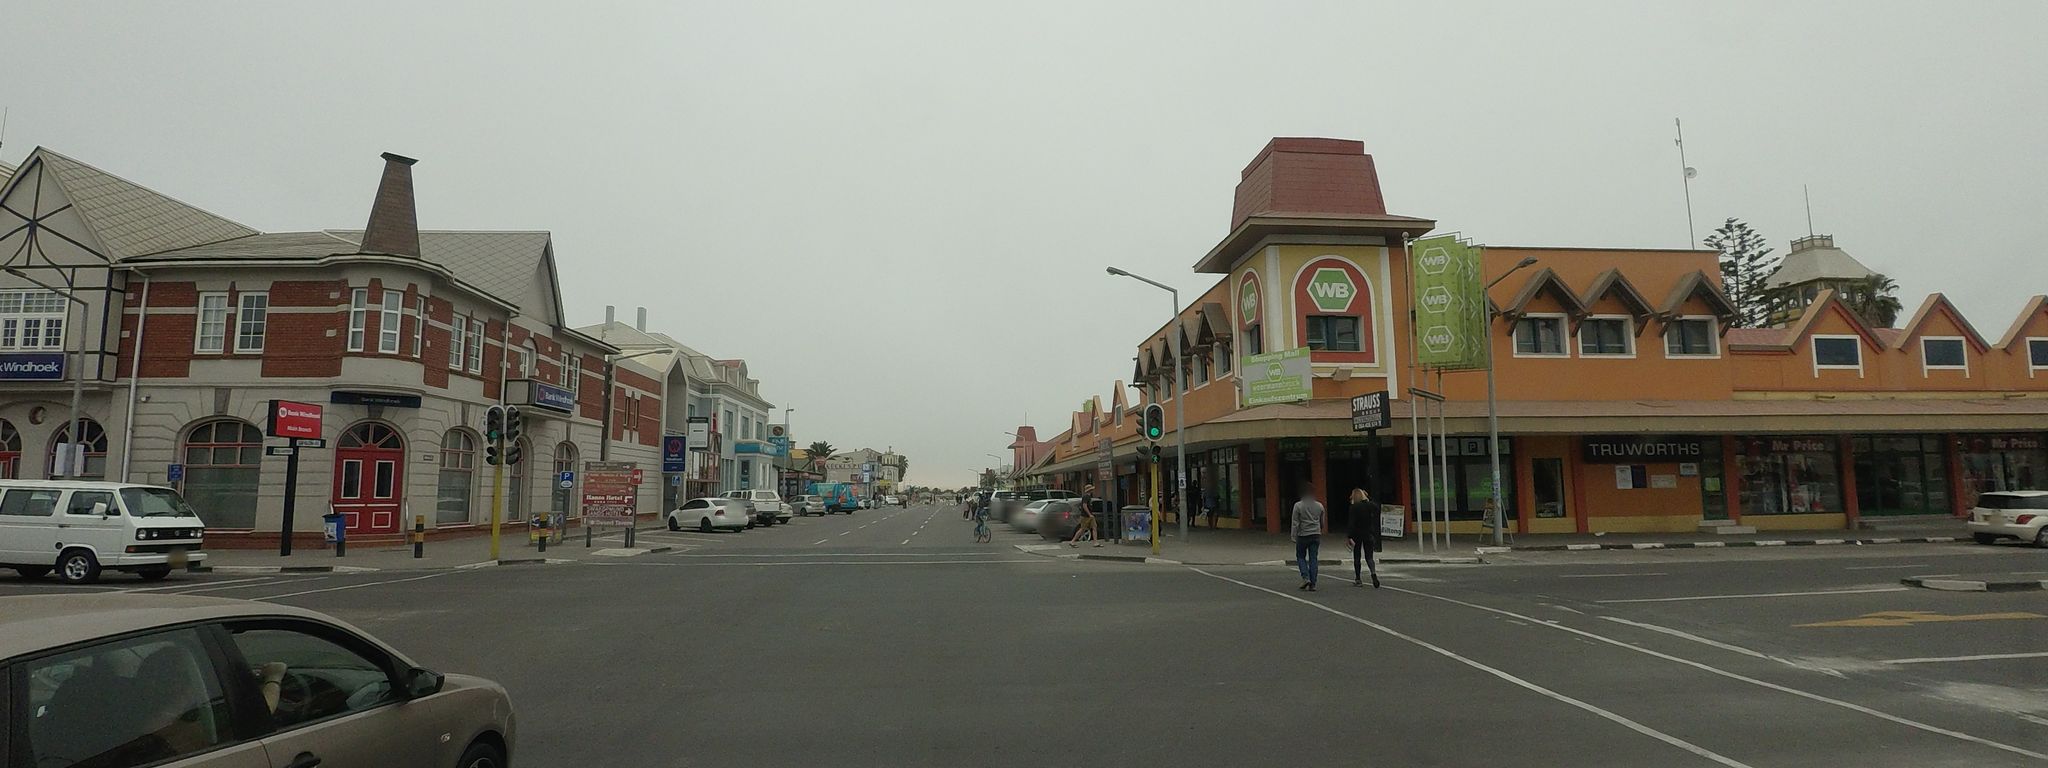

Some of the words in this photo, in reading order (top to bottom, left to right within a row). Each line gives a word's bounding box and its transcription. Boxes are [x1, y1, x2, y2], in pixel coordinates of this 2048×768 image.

[1424, 256, 1446, 265] WB
[1314, 282, 1350, 298] WB
[1243, 292, 1256, 311] WB
[1426, 295, 1447, 305] WB
[1428, 335, 1449, 344] WB
[1251, 354, 1283, 363] Shopping
[1284, 350, 1300, 358] Mall
[4, 362, 59, 372] Windhoek
[1268, 368, 1281, 376] WB
[545, 392, 555, 400] Bank
[1248, 393, 1308, 404] Einkaufszentrum
[1352, 393, 1381, 412] STRAUSS
[1772, 440, 1789, 451] Mr
[1794, 440, 1825, 451] Price
[1992, 438, 2007, 449] Mr
[2009, 438, 2038, 449] Price
[1588, 443, 1700, 456] TRUWORTHS
